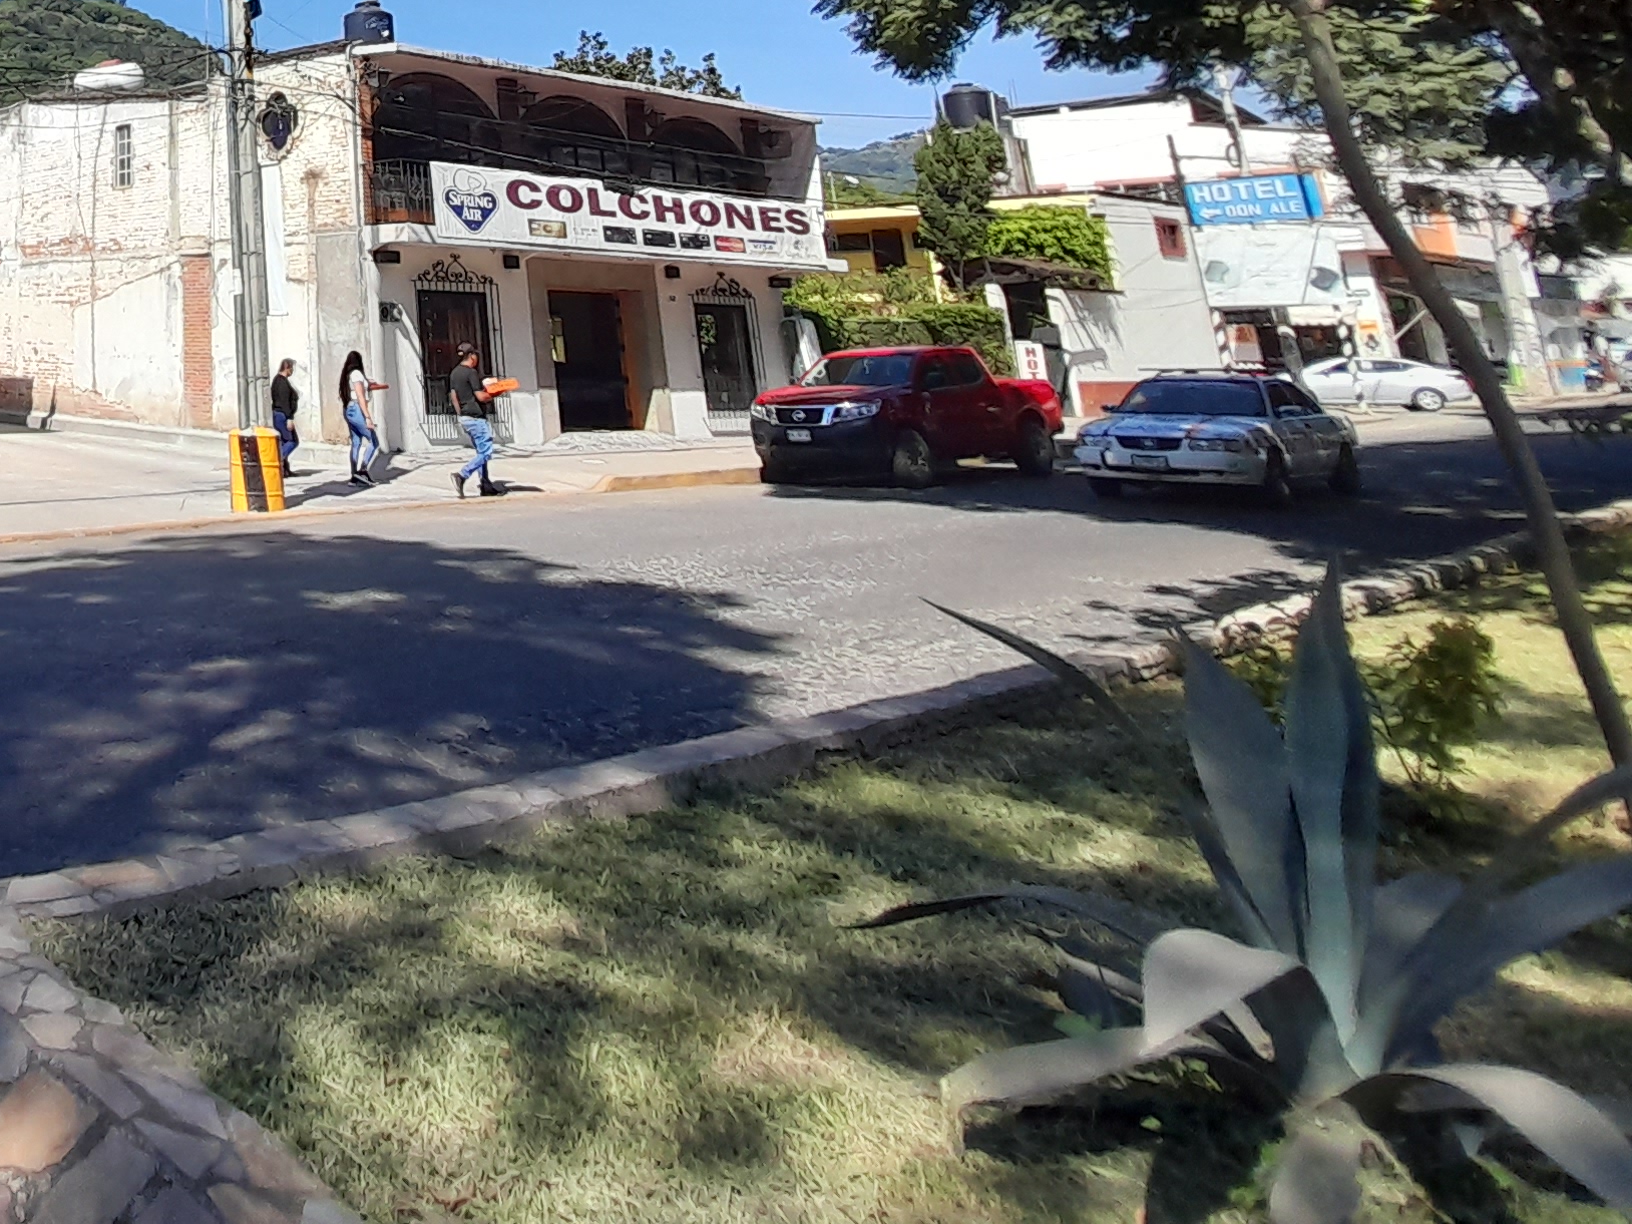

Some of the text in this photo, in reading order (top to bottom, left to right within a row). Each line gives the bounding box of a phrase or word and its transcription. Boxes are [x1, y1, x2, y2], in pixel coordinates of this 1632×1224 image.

[1191, 179, 1298, 204] HOTEL
[448, 192, 493, 209] SPRING
[506, 179, 811, 236] COLCHONES
[1225, 200, 1303, 217] DON ALE
[461, 207, 483, 221] AIR
